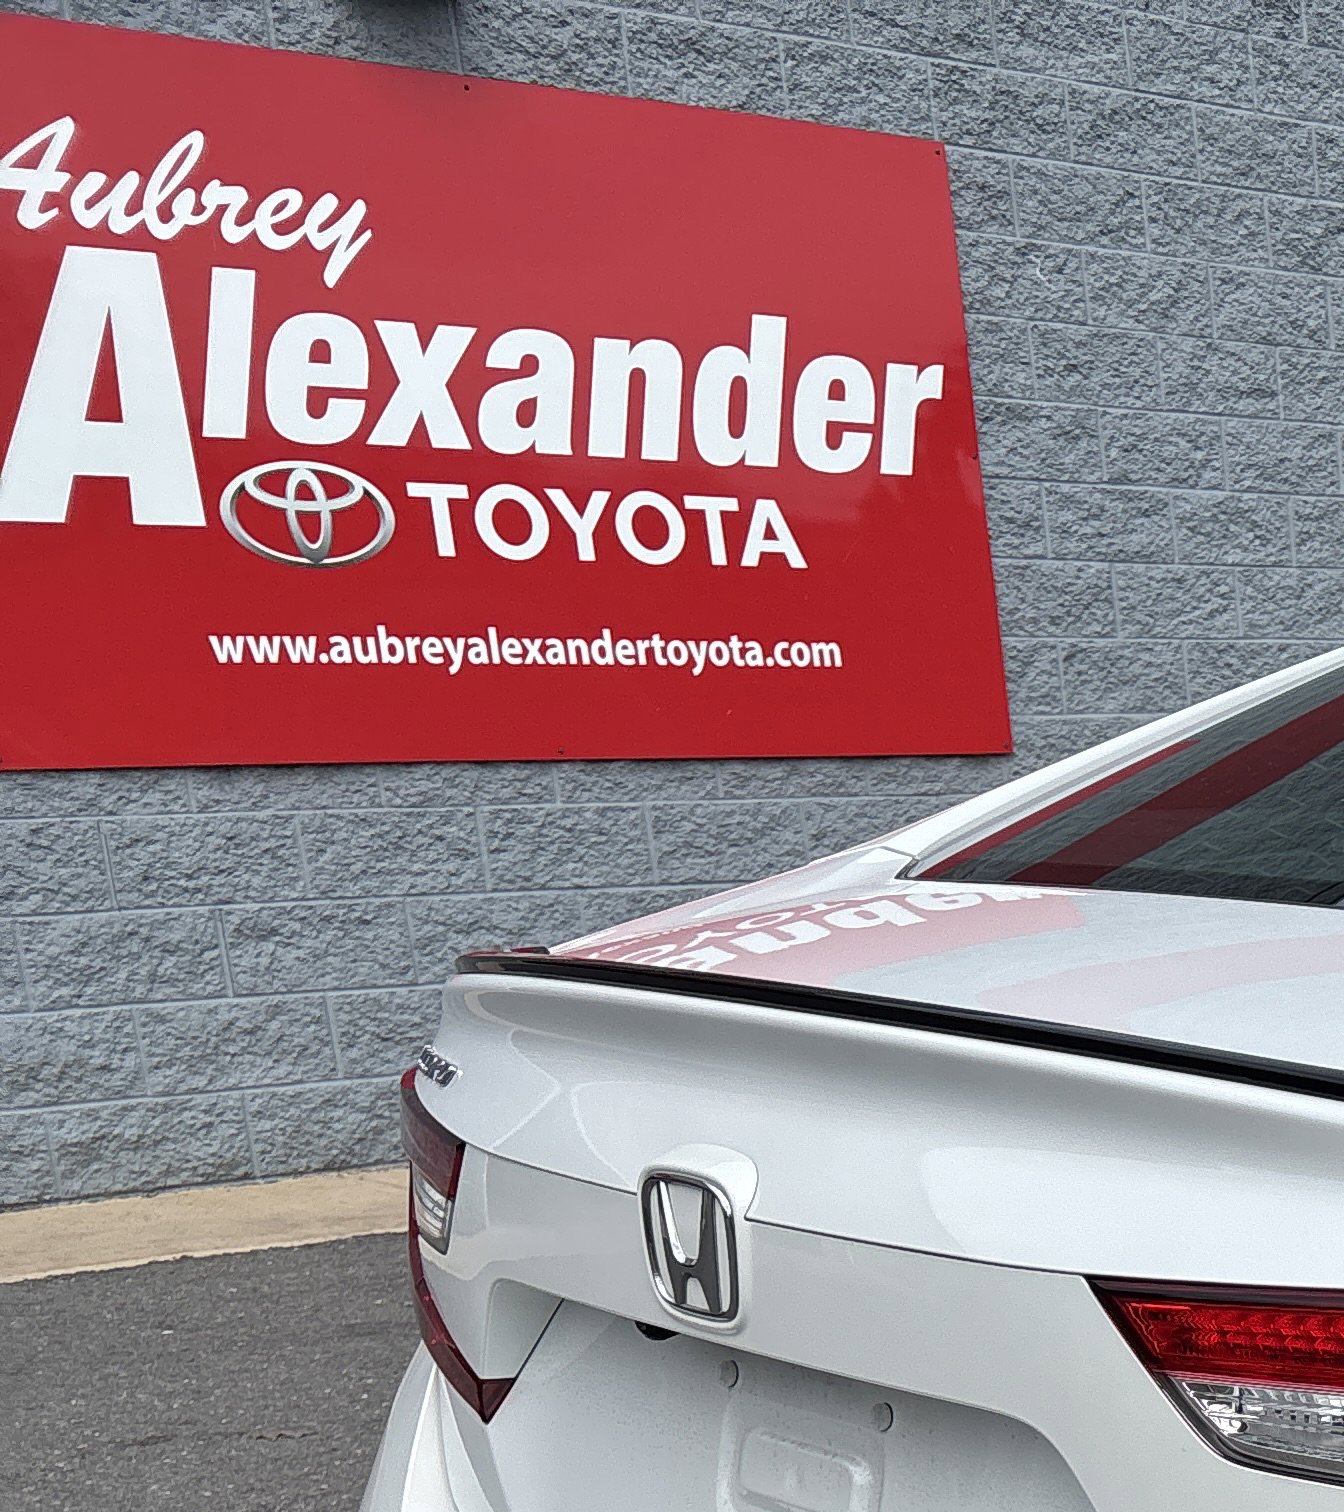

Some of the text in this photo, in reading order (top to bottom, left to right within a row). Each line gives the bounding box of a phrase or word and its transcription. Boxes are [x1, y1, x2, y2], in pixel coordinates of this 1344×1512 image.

[0, 115, 373, 289] Aubrey
[0, 244, 945, 527] Alexander
[405, 481, 809, 569] TOYOTA
[207, 624, 843, 677] www.aubreyalexandertoyota.com
